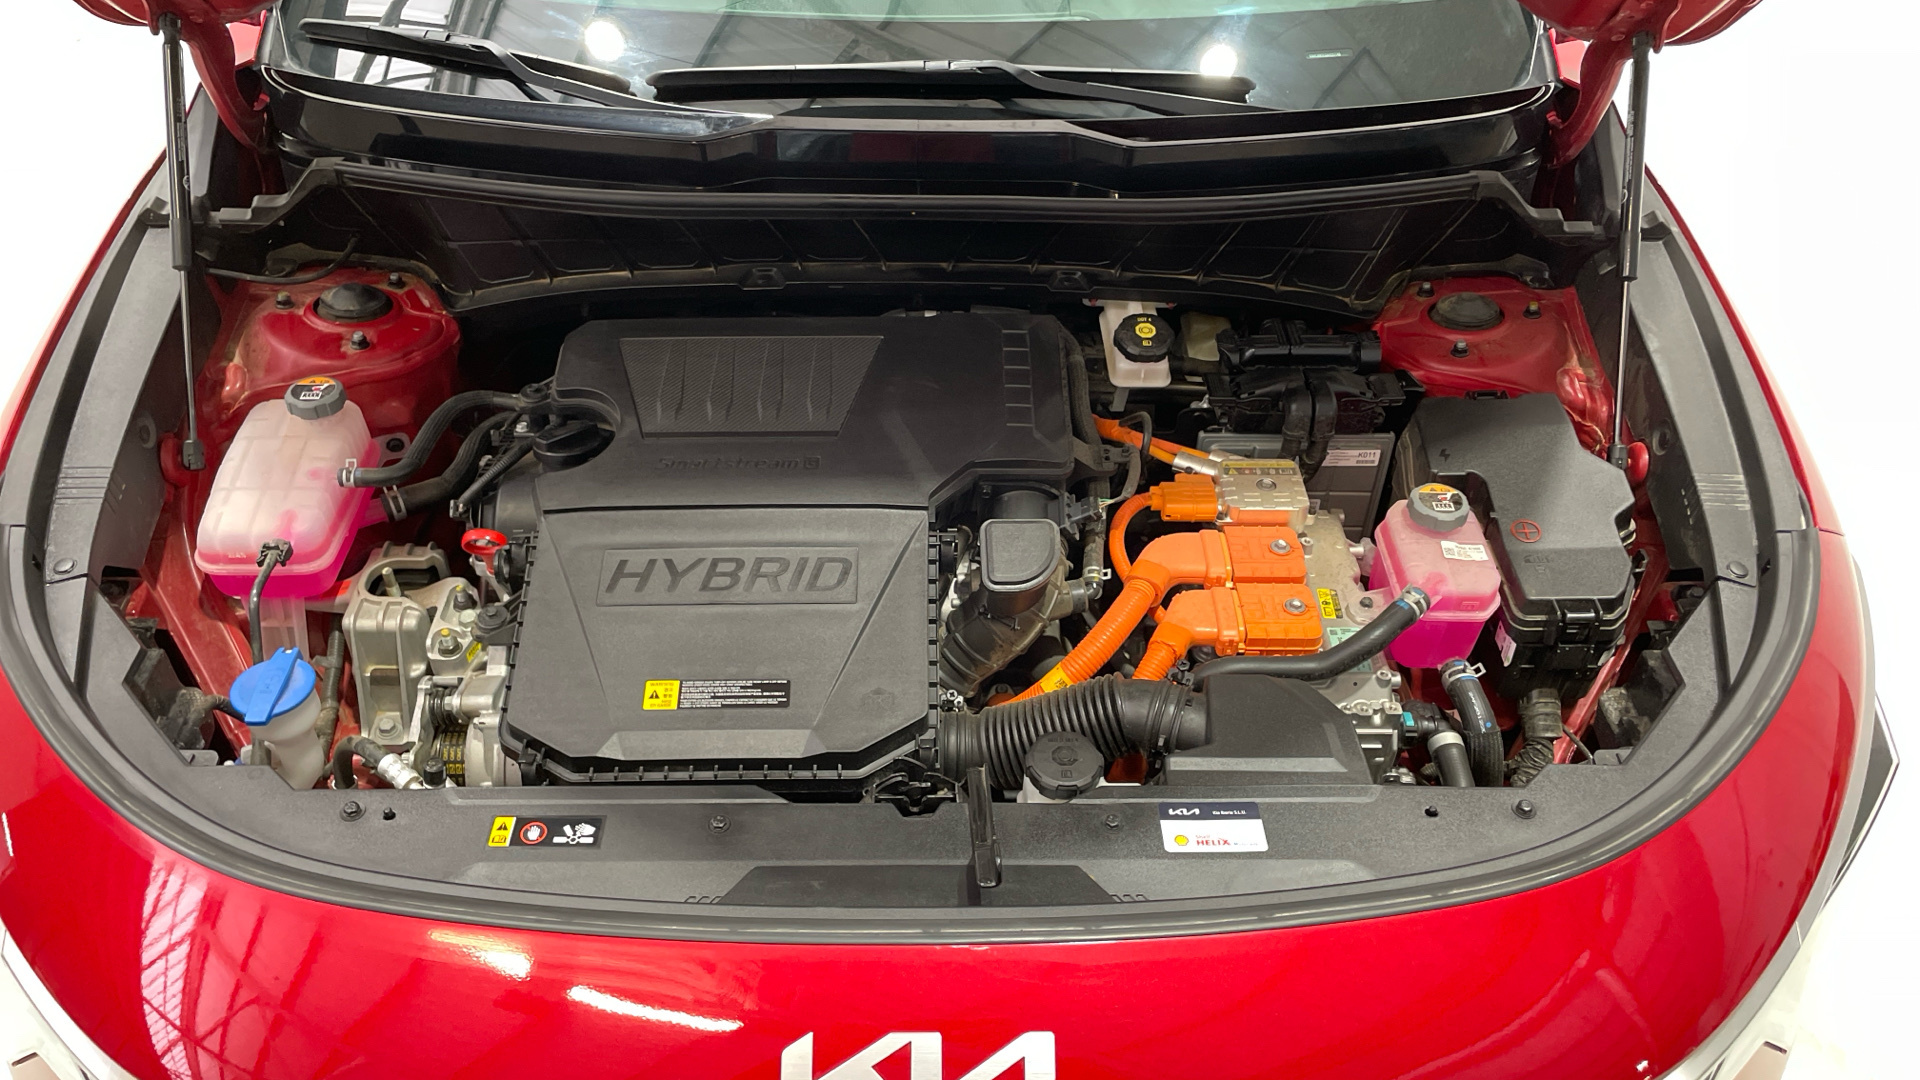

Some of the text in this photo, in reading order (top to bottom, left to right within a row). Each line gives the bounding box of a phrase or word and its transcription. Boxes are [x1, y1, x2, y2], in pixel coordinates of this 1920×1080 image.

[605, 557, 853, 593] HYBRID
[1196, 838, 1231, 846] HELIX
[781, 1031, 1056, 1080] KIA
